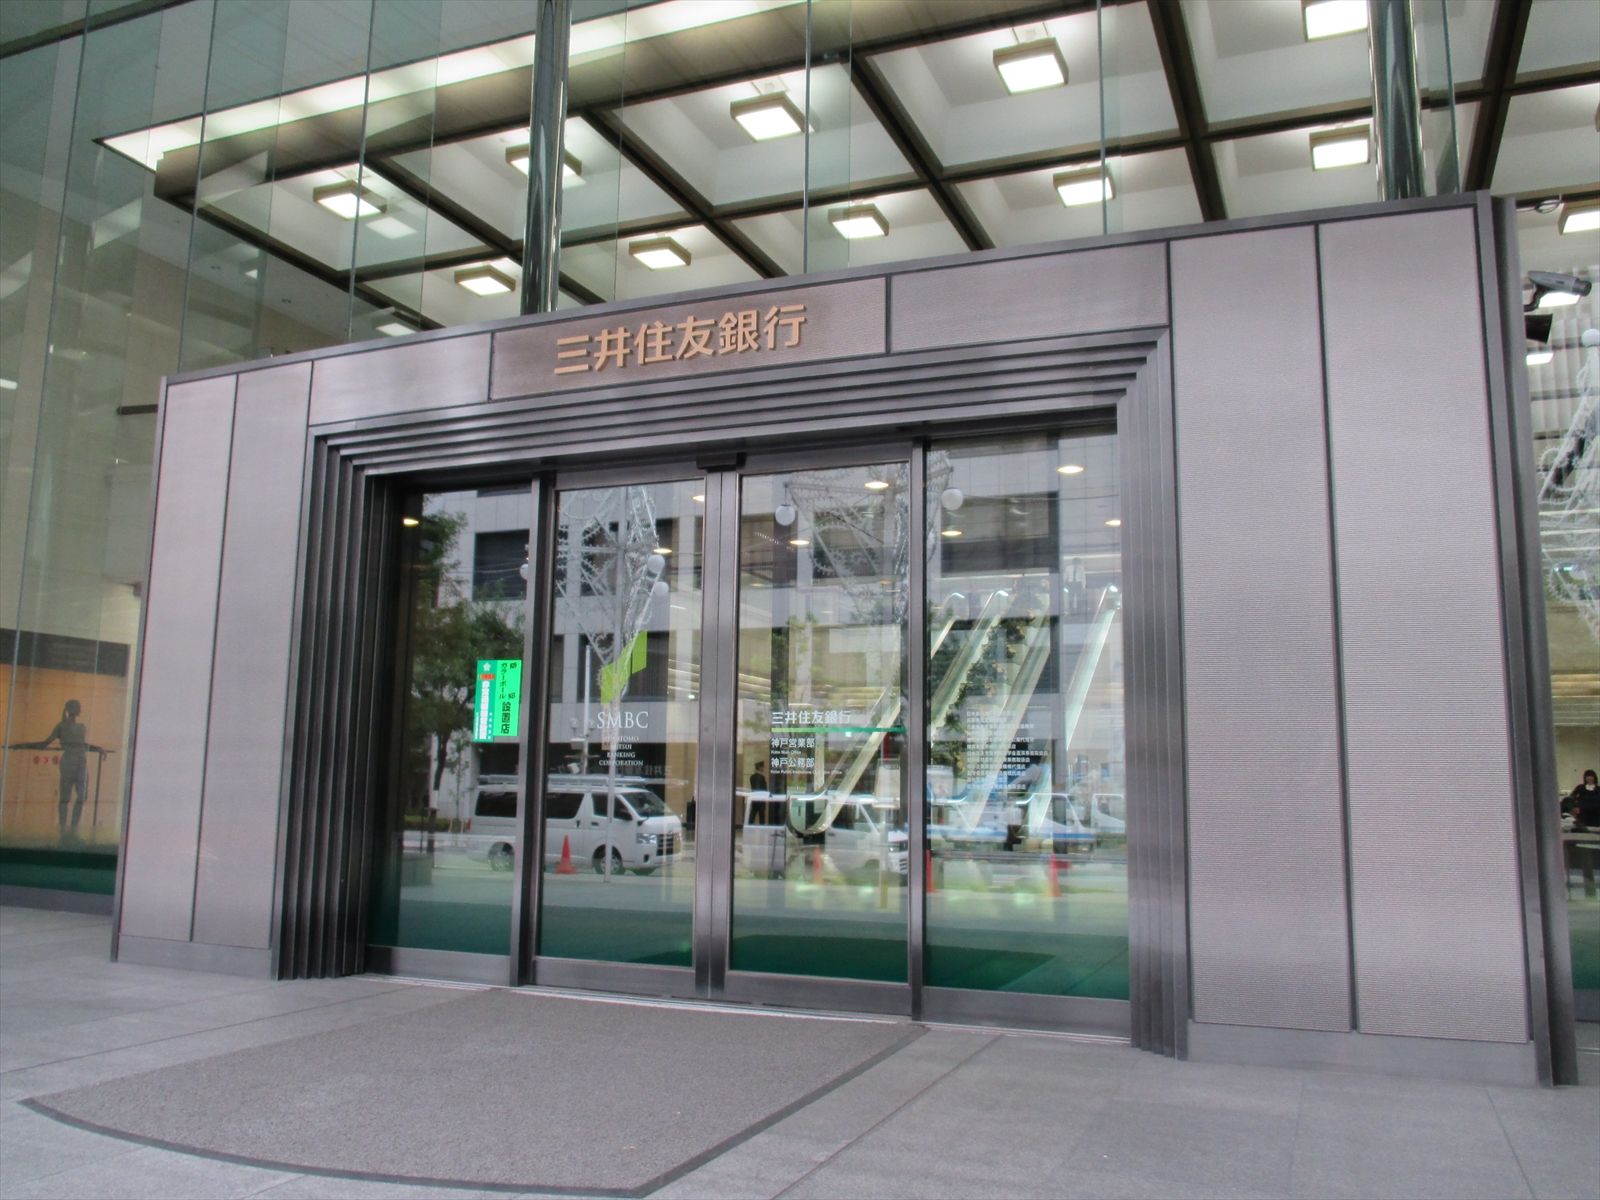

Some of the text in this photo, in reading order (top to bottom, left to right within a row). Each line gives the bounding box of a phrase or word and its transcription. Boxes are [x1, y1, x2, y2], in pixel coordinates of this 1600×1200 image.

[554, 304, 807, 375] 三井住友銀行
[501, 702, 512, 734] 設置店
[596, 711, 649, 729] SMBC
[771, 710, 852, 725] 三井住友銀行
[771, 738, 815, 748] 神戸営業部
[598, 759, 644, 767] COORATION
